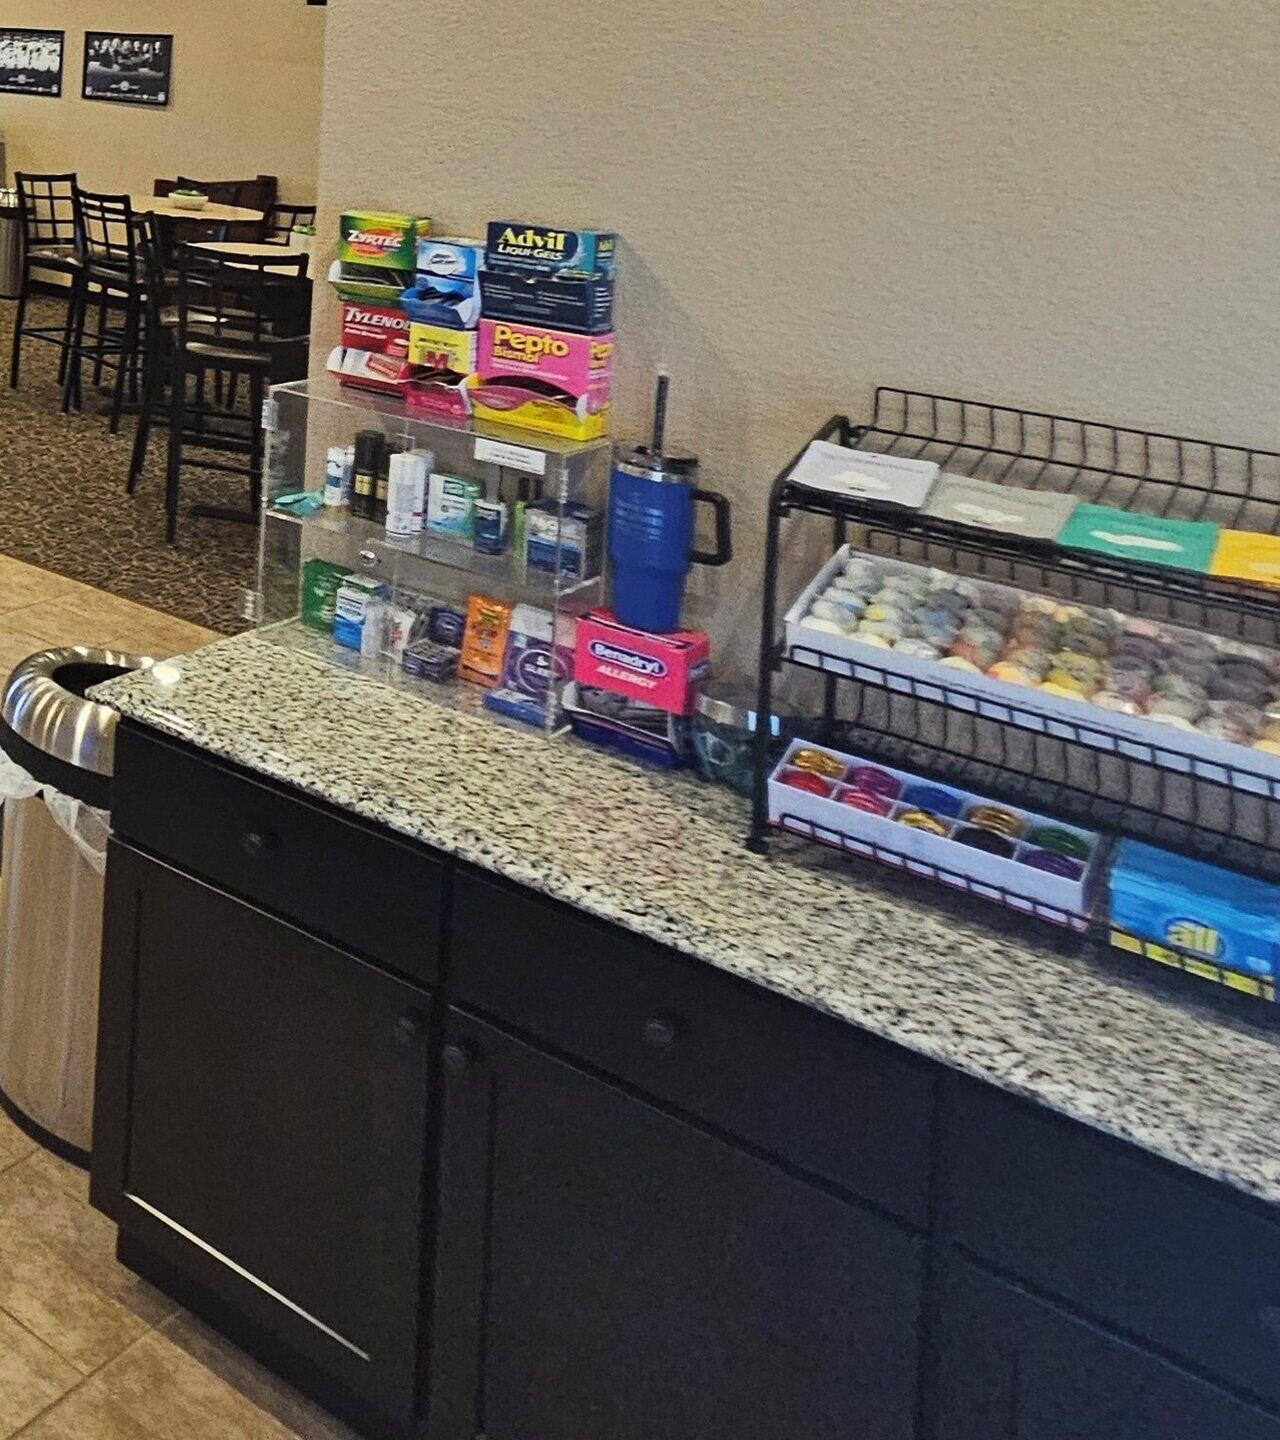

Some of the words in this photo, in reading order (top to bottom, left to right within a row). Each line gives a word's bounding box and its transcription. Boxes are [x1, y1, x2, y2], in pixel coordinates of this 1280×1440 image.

[348, 229, 404, 248] ZYRTEC
[497, 226, 567, 251] Advil
[493, 324, 569, 357] Pepto
[594, 643, 661, 674] Benadryl
[1166, 920, 1219, 957] all
